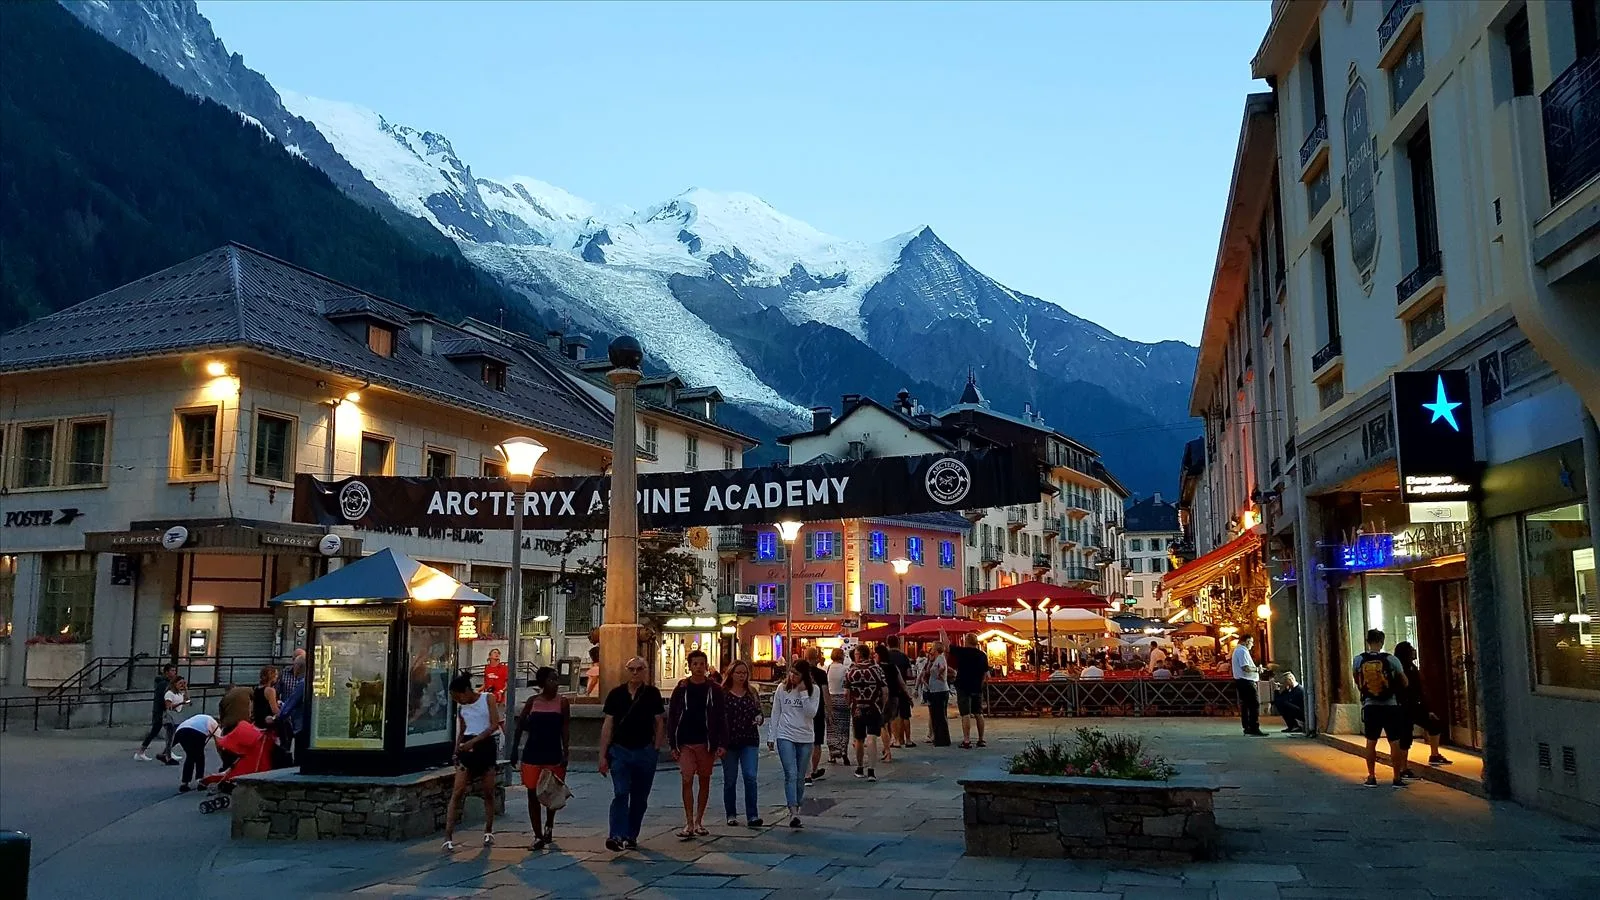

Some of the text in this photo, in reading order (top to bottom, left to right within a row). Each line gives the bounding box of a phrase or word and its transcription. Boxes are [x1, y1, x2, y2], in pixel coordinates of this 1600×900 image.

[426, 476, 850, 516] ARC'TERYX AINE ACADEMY
[4, 510, 54, 527] POSTE
[521, 536, 532, 550] A
[791, 623, 834, 632] National
